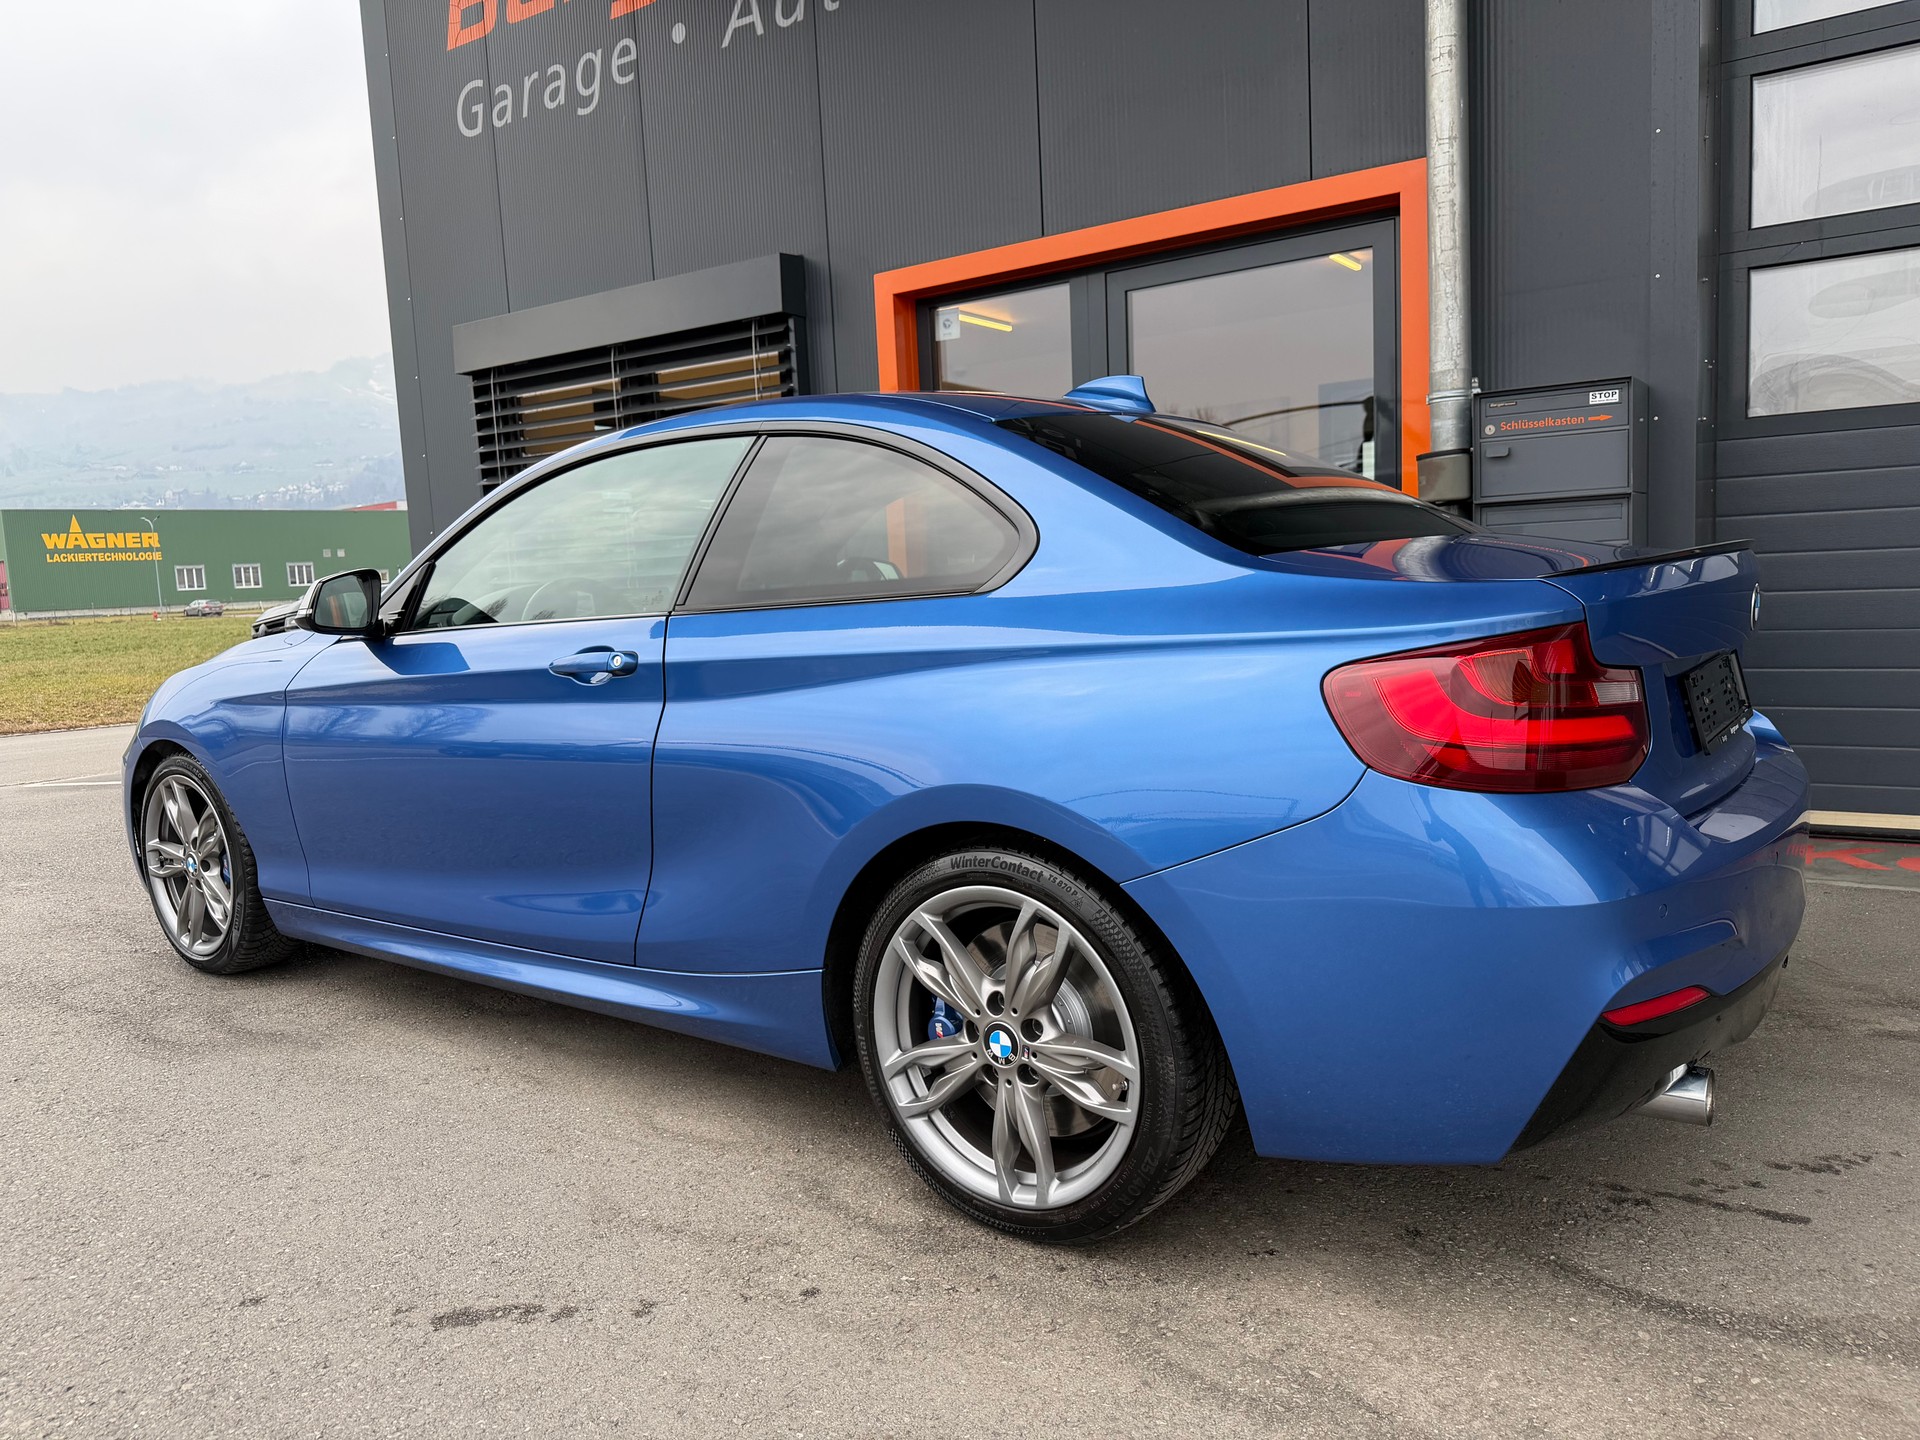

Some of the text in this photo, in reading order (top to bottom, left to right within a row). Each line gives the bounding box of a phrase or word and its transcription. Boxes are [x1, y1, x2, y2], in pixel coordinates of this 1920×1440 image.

[456, 37, 638, 137] Garage
[720, 0, 841, 48] Au
[1591, 390, 1618, 400] STOP
[1500, 415, 1585, 431] Schlüsselkasten
[41, 514, 161, 549] WAGNER
[46, 552, 163, 563] LACKIERTECHNOLOGIE
[950, 855, 1044, 882] WinterContact
